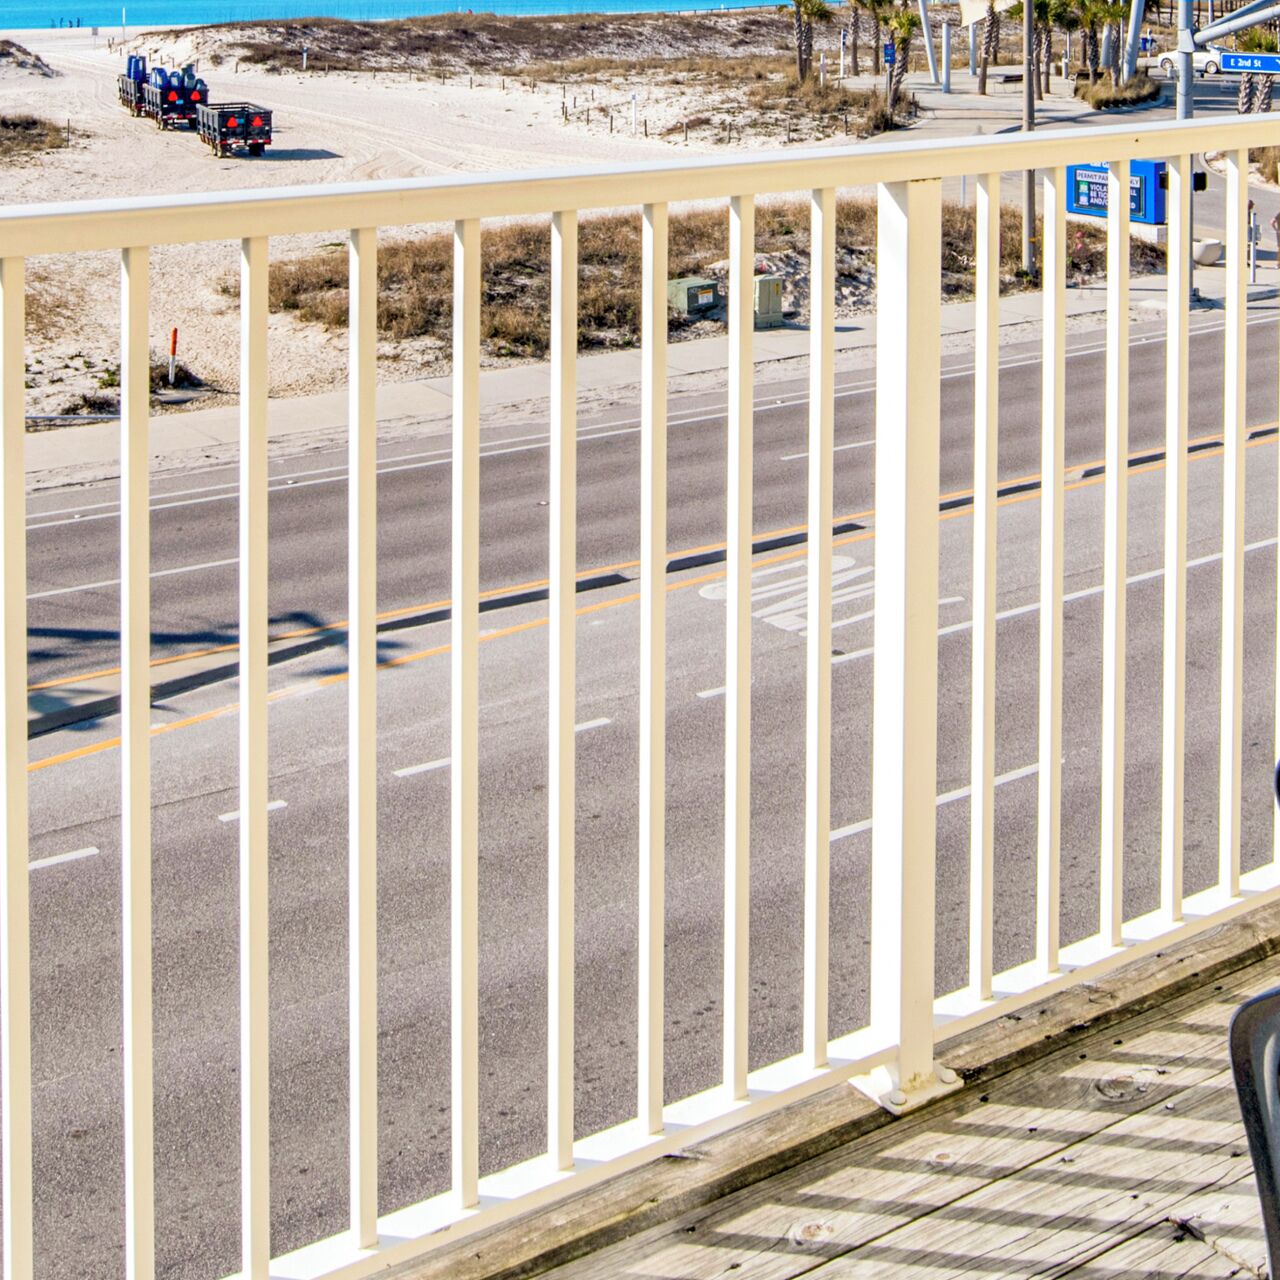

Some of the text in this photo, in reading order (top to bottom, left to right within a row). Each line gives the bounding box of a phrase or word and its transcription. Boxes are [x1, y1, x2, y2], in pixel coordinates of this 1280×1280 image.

[1230, 58, 1261, 67] E 2nd St
[1078, 172, 1097, 181] PERMIT
